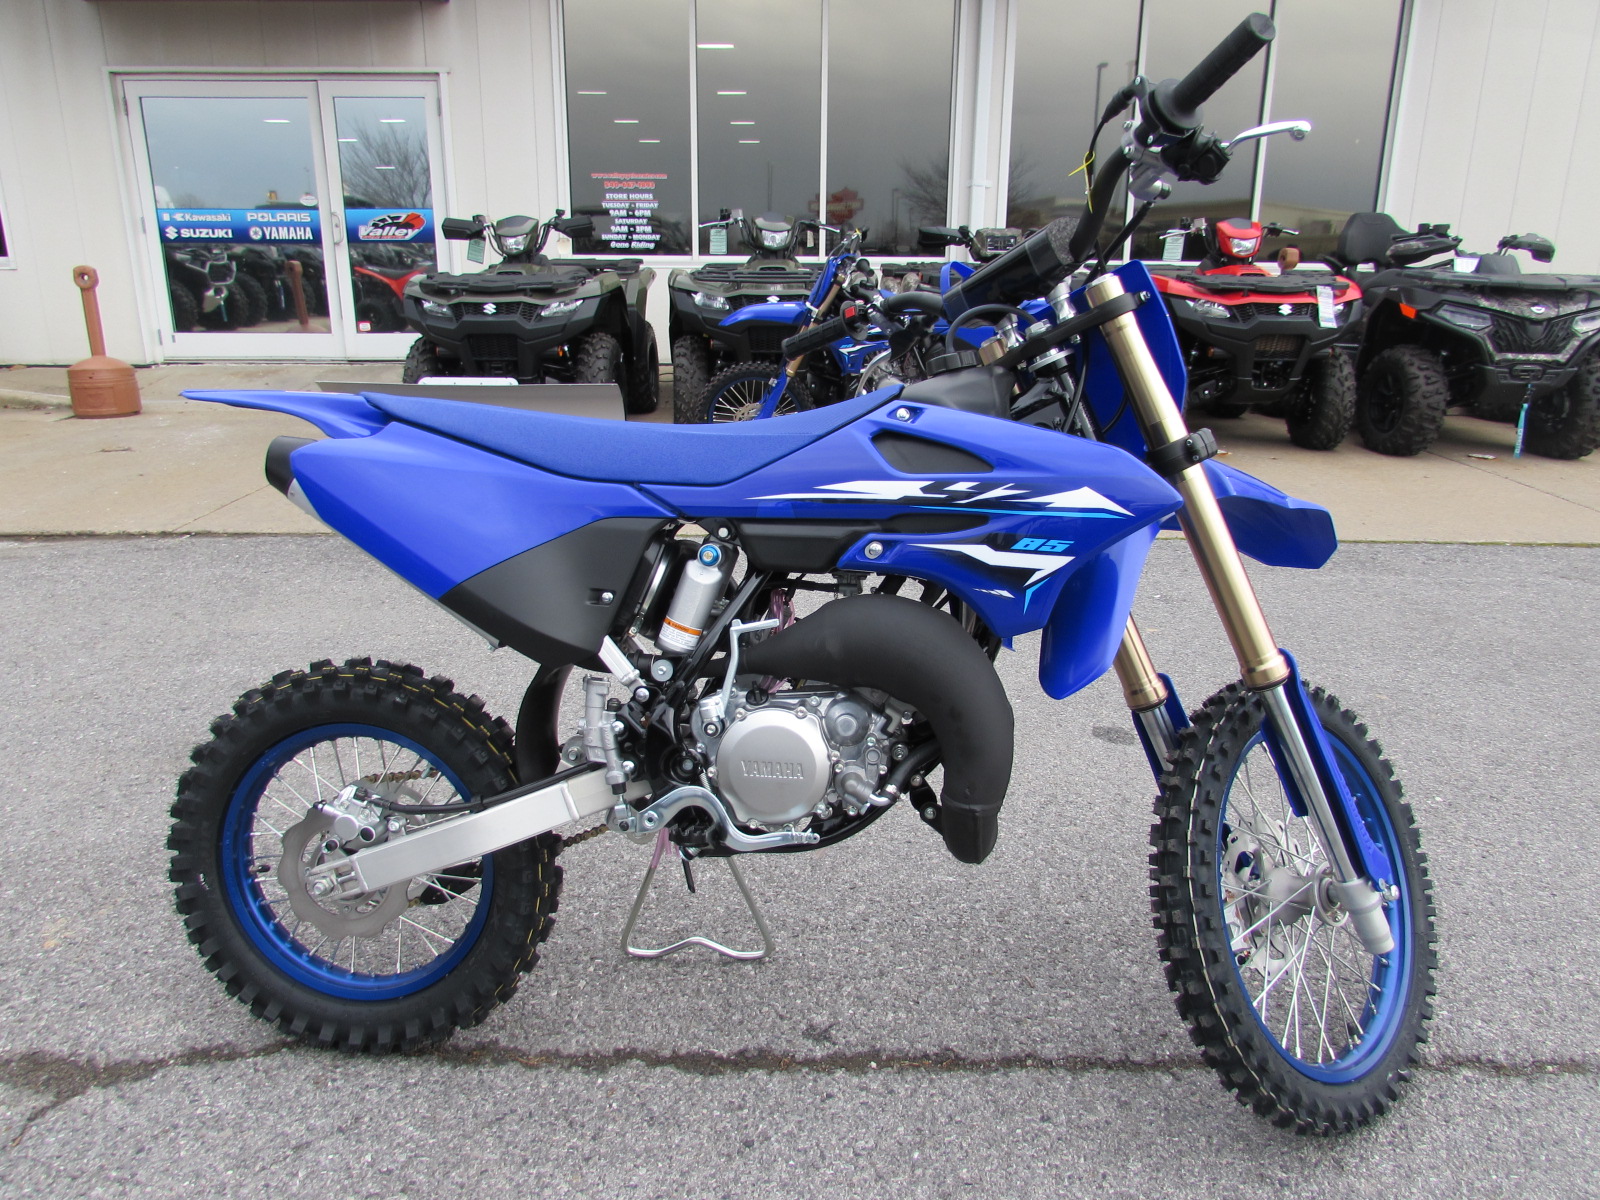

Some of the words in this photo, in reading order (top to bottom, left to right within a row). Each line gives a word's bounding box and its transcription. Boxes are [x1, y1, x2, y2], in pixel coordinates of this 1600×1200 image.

[185, 213, 231, 222] Kawasaki
[247, 212, 311, 222] POLARIS
[180, 228, 233, 238] SUZUKI
[263, 226, 313, 240] YAMAHA
[360, 225, 418, 239] Valley
[610, 241, 630, 249] Gone
[631, 241, 656, 250] Riding
[1010, 537, 1075, 553] 85
[740, 760, 804, 779] YAMAHA
